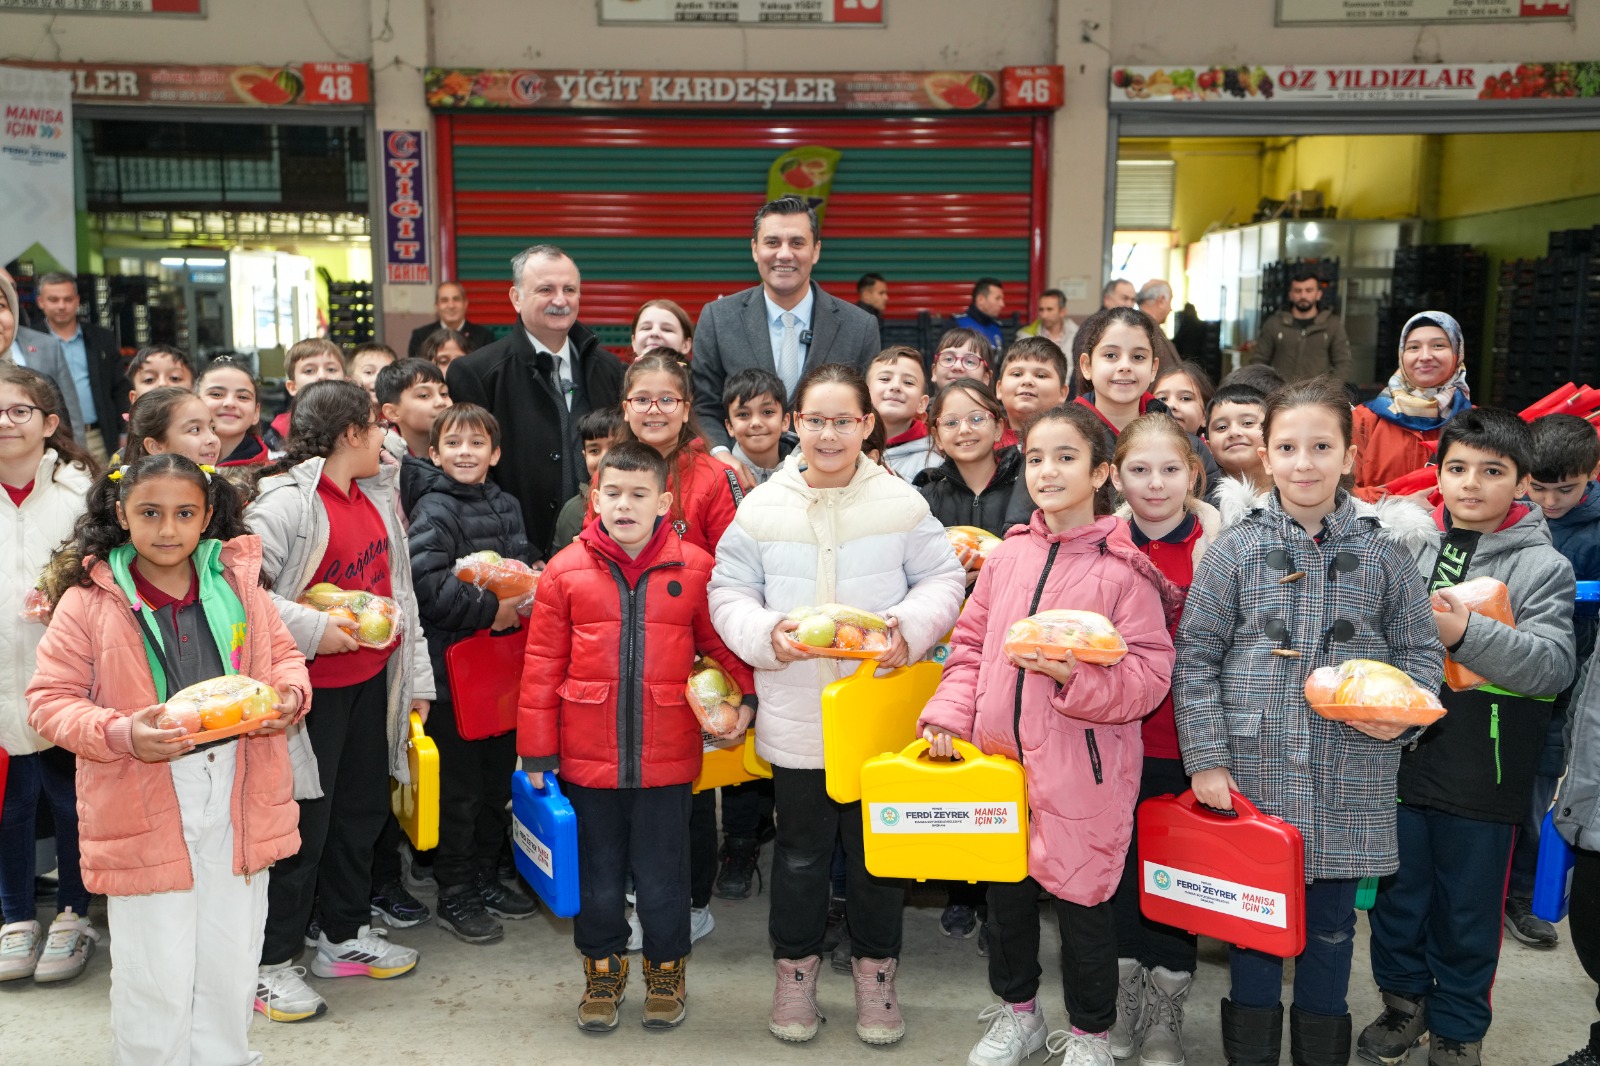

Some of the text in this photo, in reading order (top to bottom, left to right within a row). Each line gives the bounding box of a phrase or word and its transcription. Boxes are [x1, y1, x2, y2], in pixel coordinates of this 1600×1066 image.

[1278, 64, 1477, 91] ÖZ YILDIZLAR
[319, 76, 352, 101] 48
[553, 70, 643, 101] YİĞİT
[650, 76, 837, 109] KARDEŞLER
[1018, 79, 1050, 104] 46
[934, 811, 970, 819] ZEYREK
[974, 807, 1008, 816] MANİSA
[975, 816, 993, 827] İÇİN
[1202, 885, 1237, 901] ZEYREK
[1241, 892, 1276, 907] MANİSA
[1242, 901, 1260, 913] İÇİN
